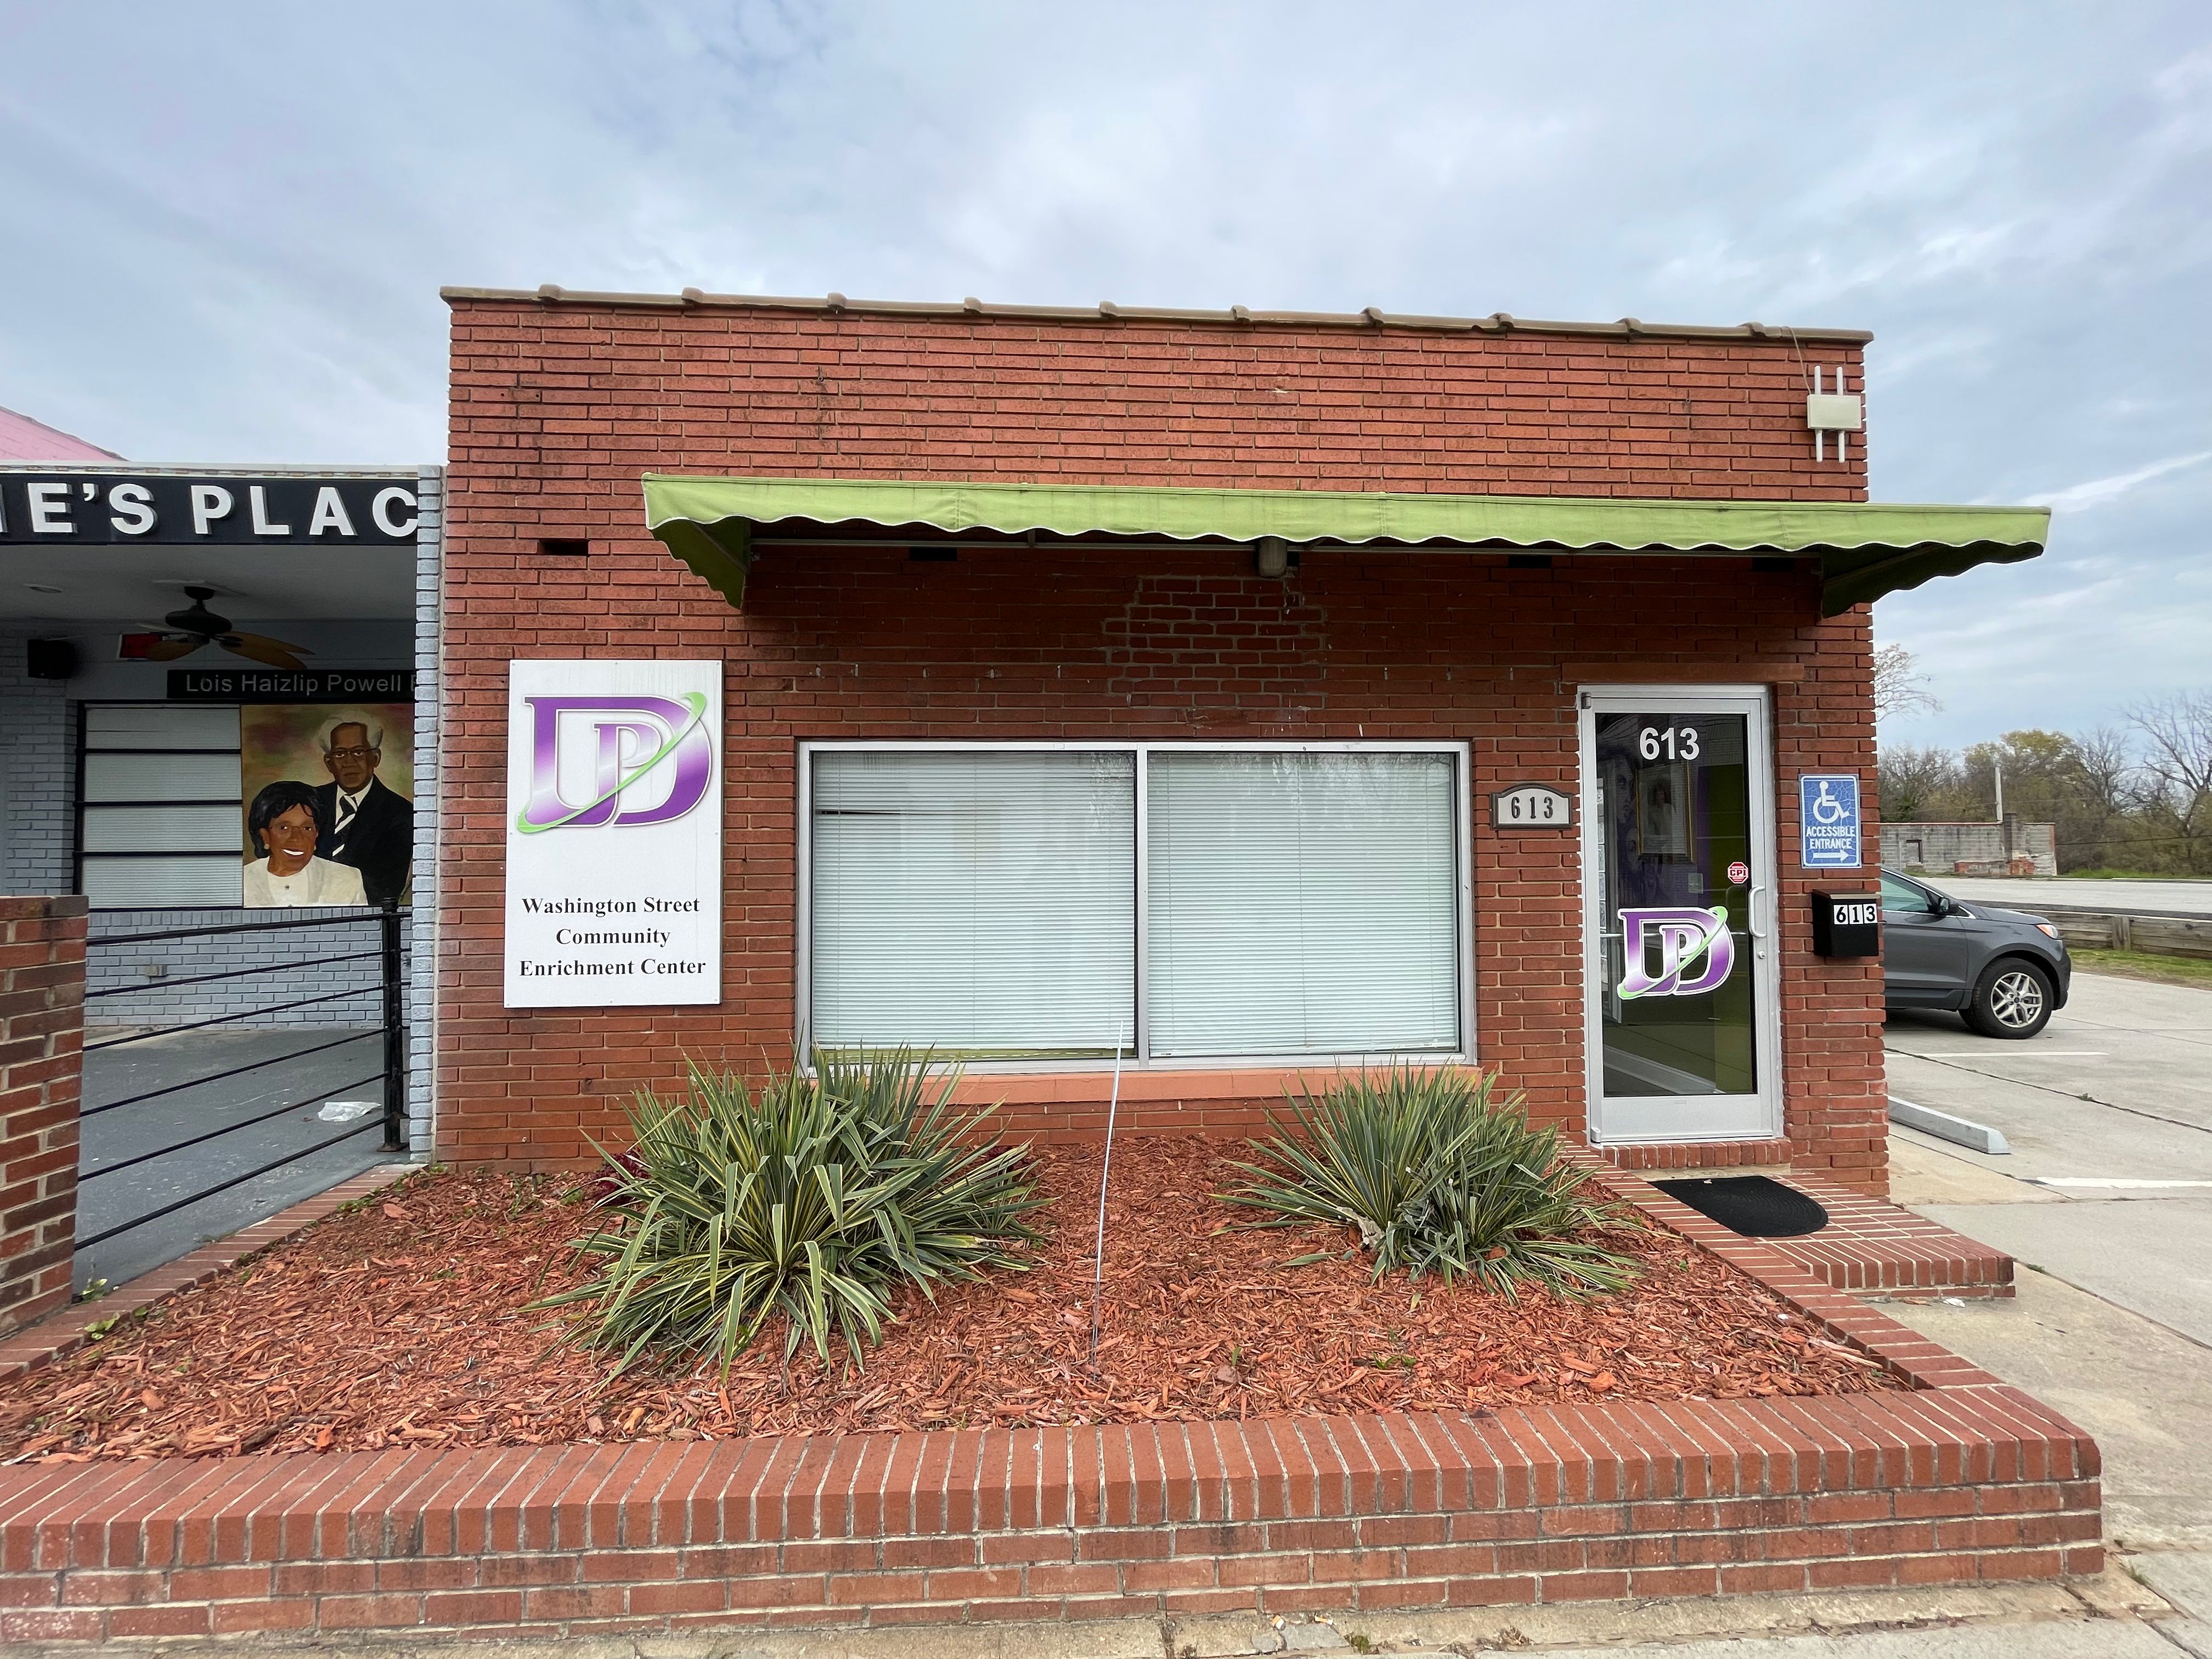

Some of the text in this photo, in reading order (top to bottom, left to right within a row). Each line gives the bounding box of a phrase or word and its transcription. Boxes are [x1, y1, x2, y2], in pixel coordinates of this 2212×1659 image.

[187, 674, 233, 692] Lois
[242, 674, 318, 696] Haizlip
[328, 674, 401, 692] Powell
[1639, 727, 1700, 760] 613
[1511, 796, 1553, 819] 613
[1806, 826, 1856, 837] ACCESSIBLE
[1810, 838, 1853, 849] ENTRANCE
[522, 896, 700, 917] Washington Street
[1836, 905, 1875, 923] 613
[556, 928, 670, 947] Community
[519, 958, 706, 977] Enrichment Center
